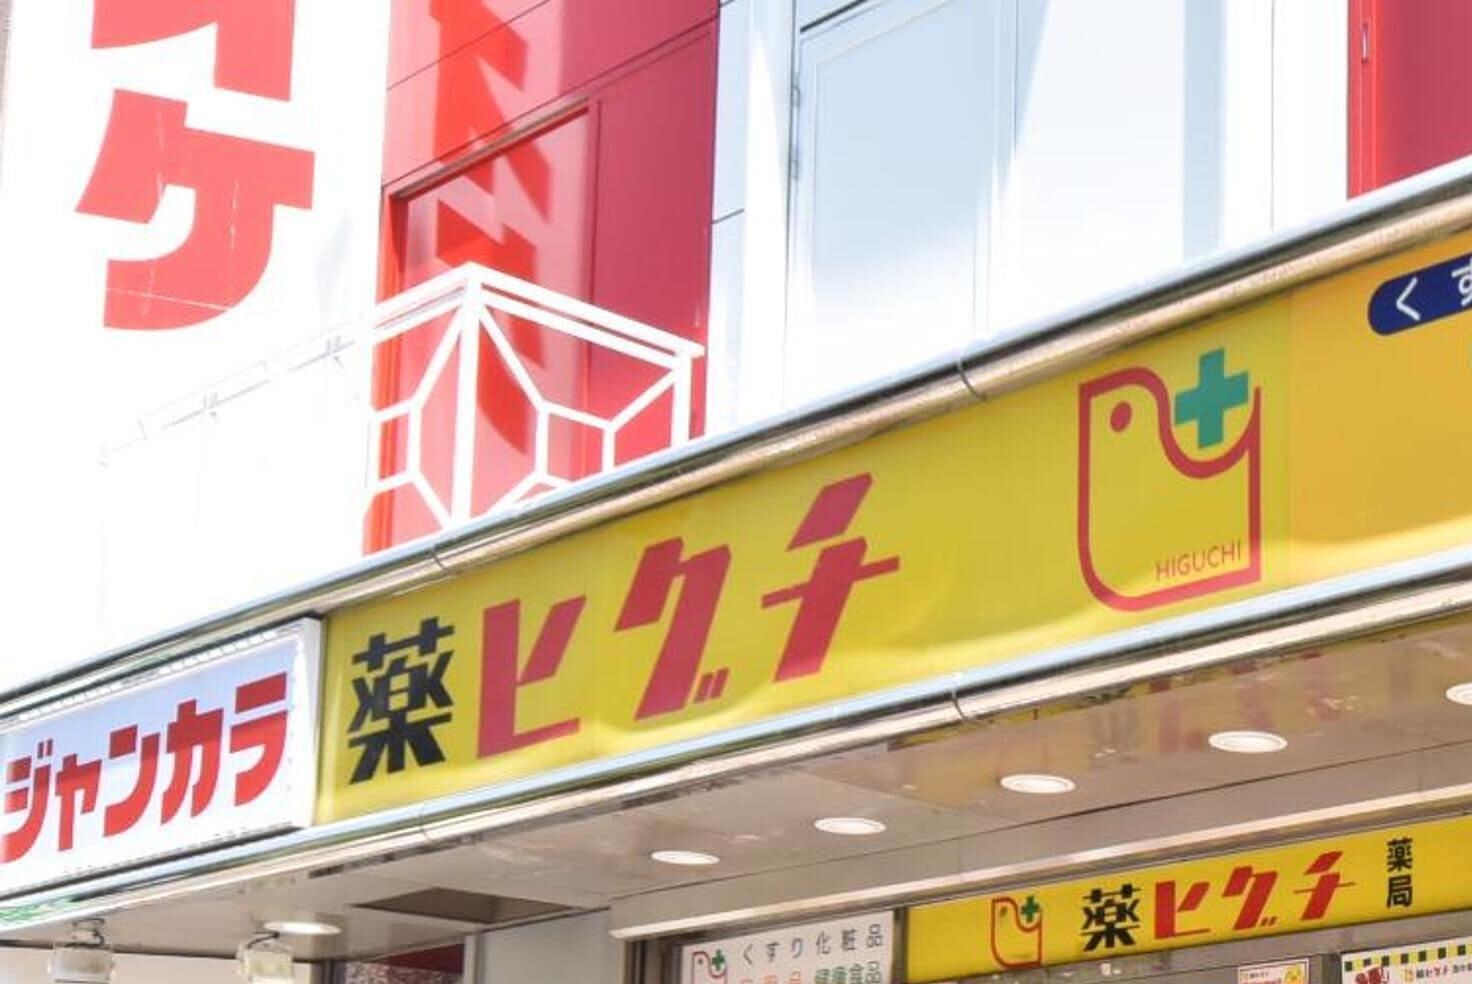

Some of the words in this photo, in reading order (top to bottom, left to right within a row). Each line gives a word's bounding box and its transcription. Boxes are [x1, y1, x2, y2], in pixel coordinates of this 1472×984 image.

[1155, 540, 1244, 583] HIGUCHI
[348, 473, 900, 784] 薬ヒグチ
[0, 672, 288, 864] ジャンカラ
[1080, 850, 1357, 953] 薬ヒグチ
[1386, 837, 1413, 910] 薬局
